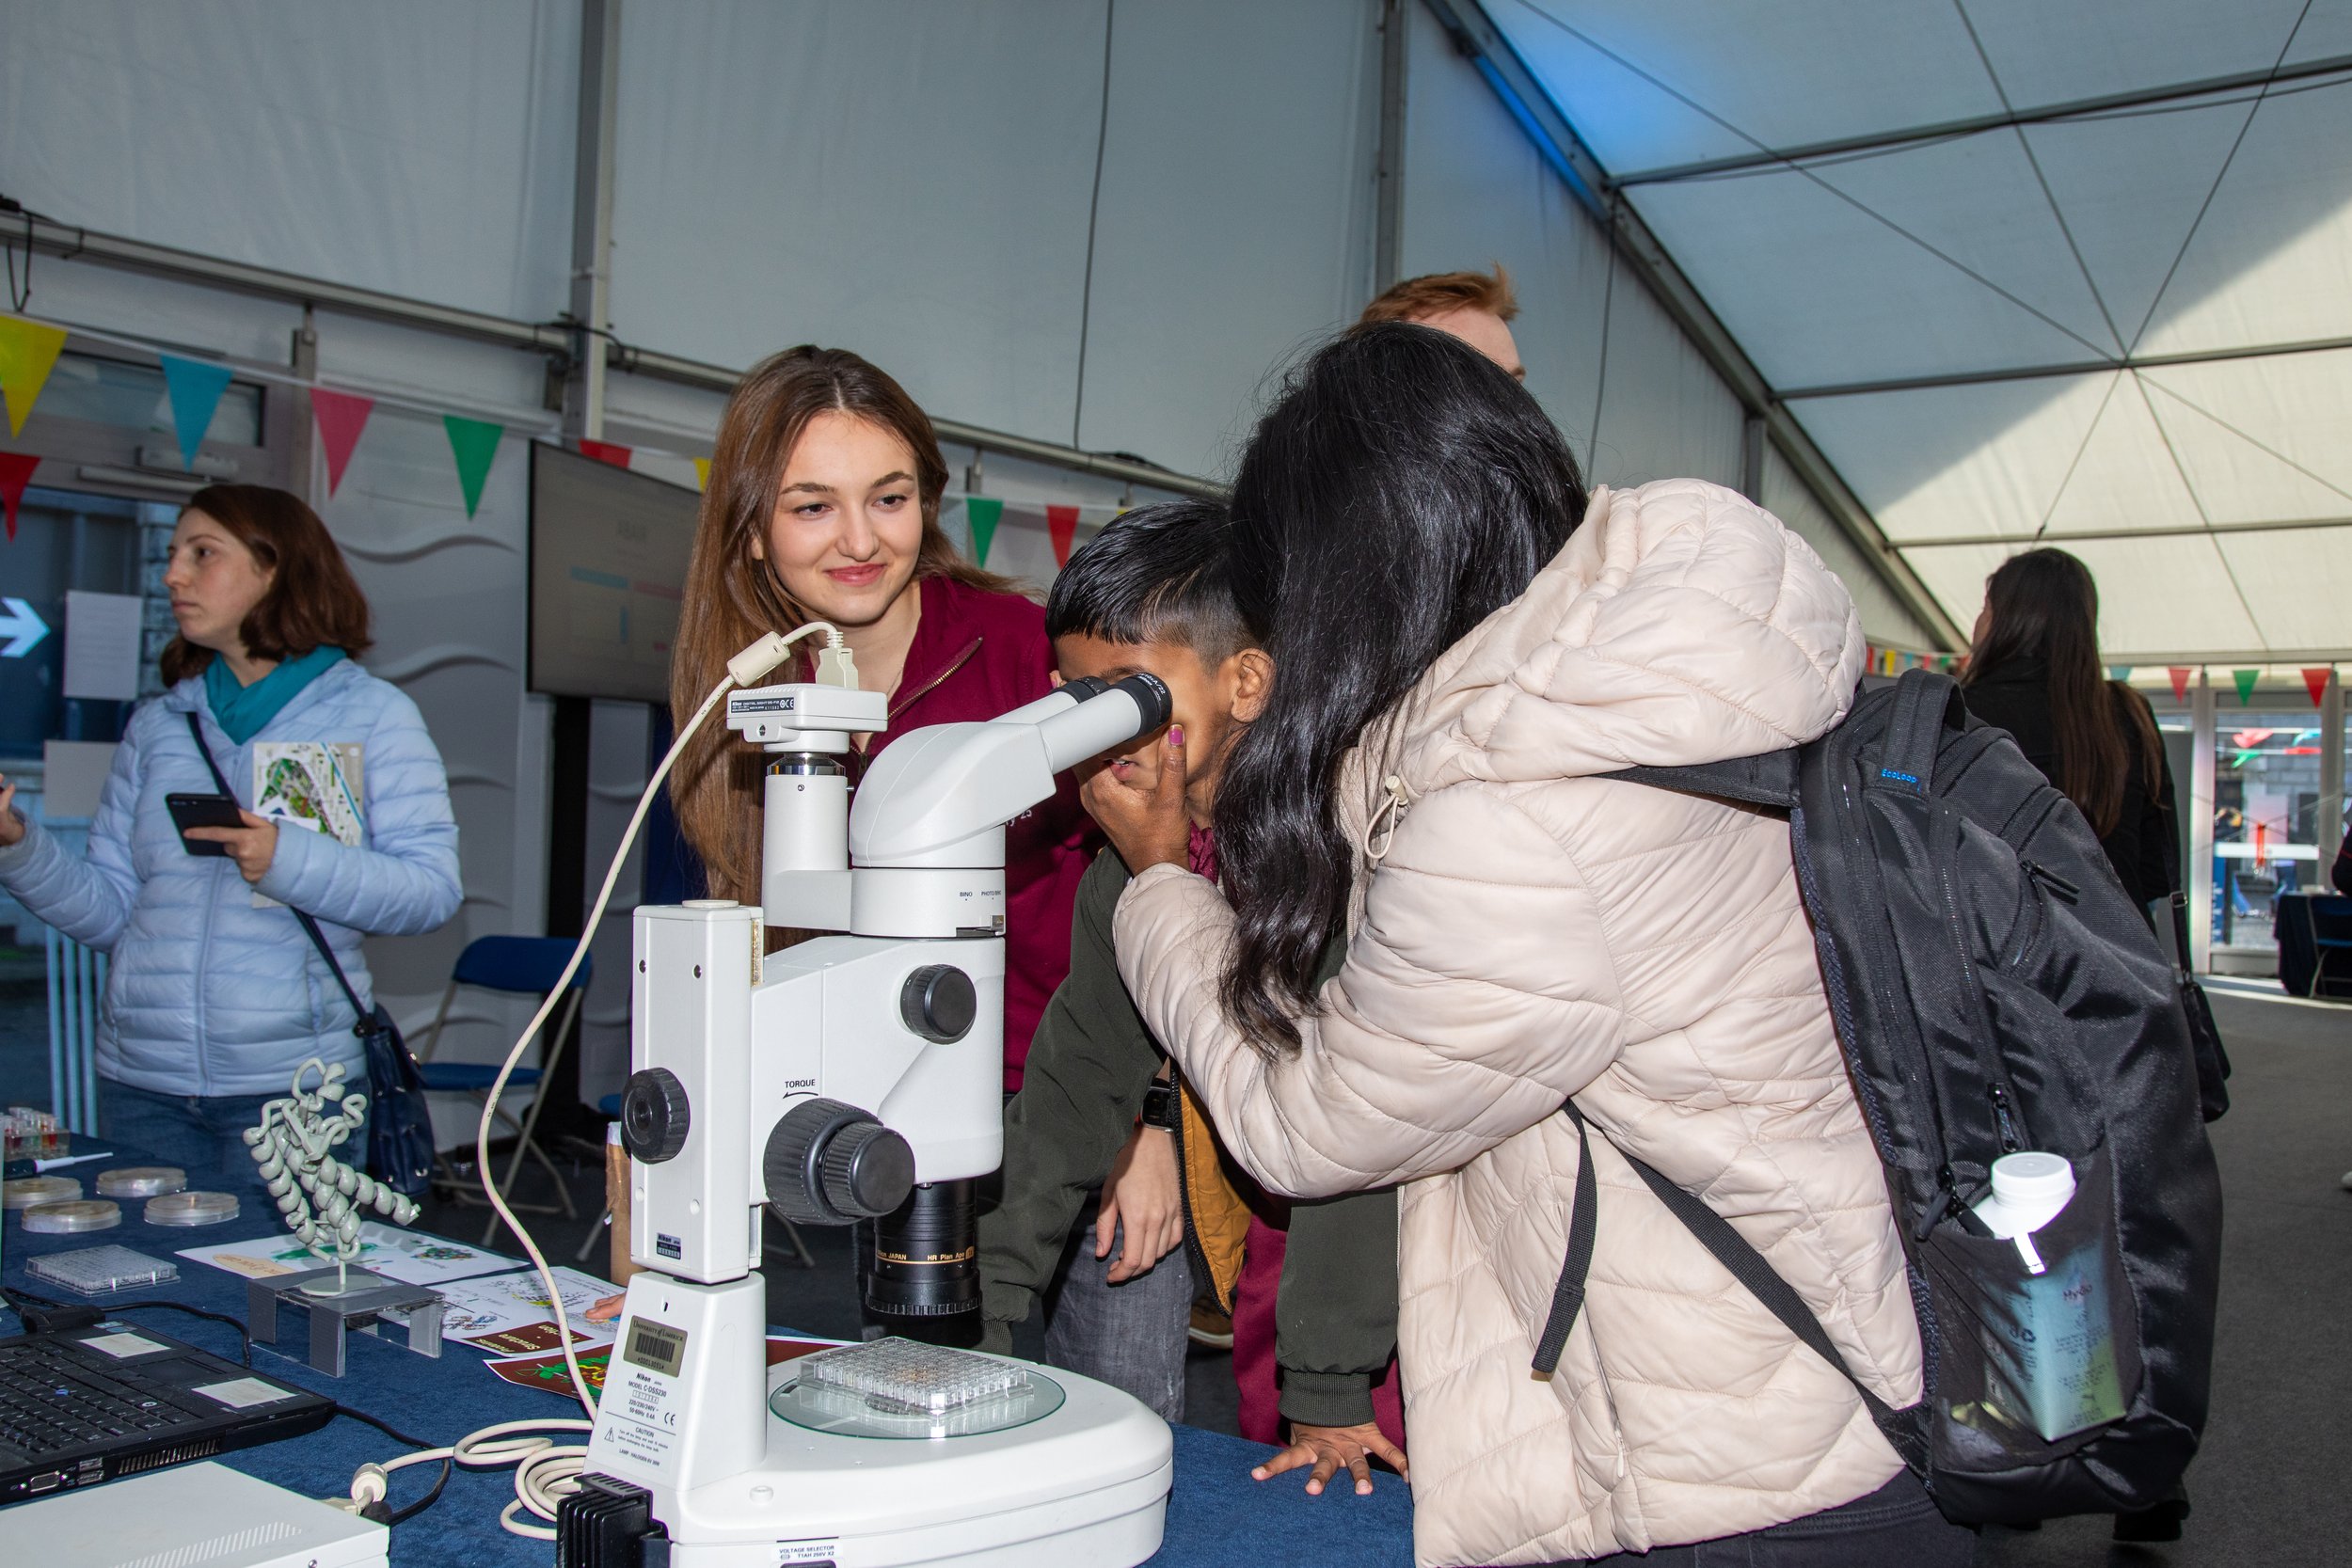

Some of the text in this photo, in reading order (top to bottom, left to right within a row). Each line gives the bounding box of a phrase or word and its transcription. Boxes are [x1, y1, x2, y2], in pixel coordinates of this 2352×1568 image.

[785, 1079, 816, 1089] TORQUE
[888, 1252, 907, 1260] JAPAN
[636, 1372, 651, 1383] Nikon
[628, 1380, 643, 1391] MODEL
[644, 1385, 667, 1398] C-DSS230
[635, 1426, 655, 1438] CAUTION
